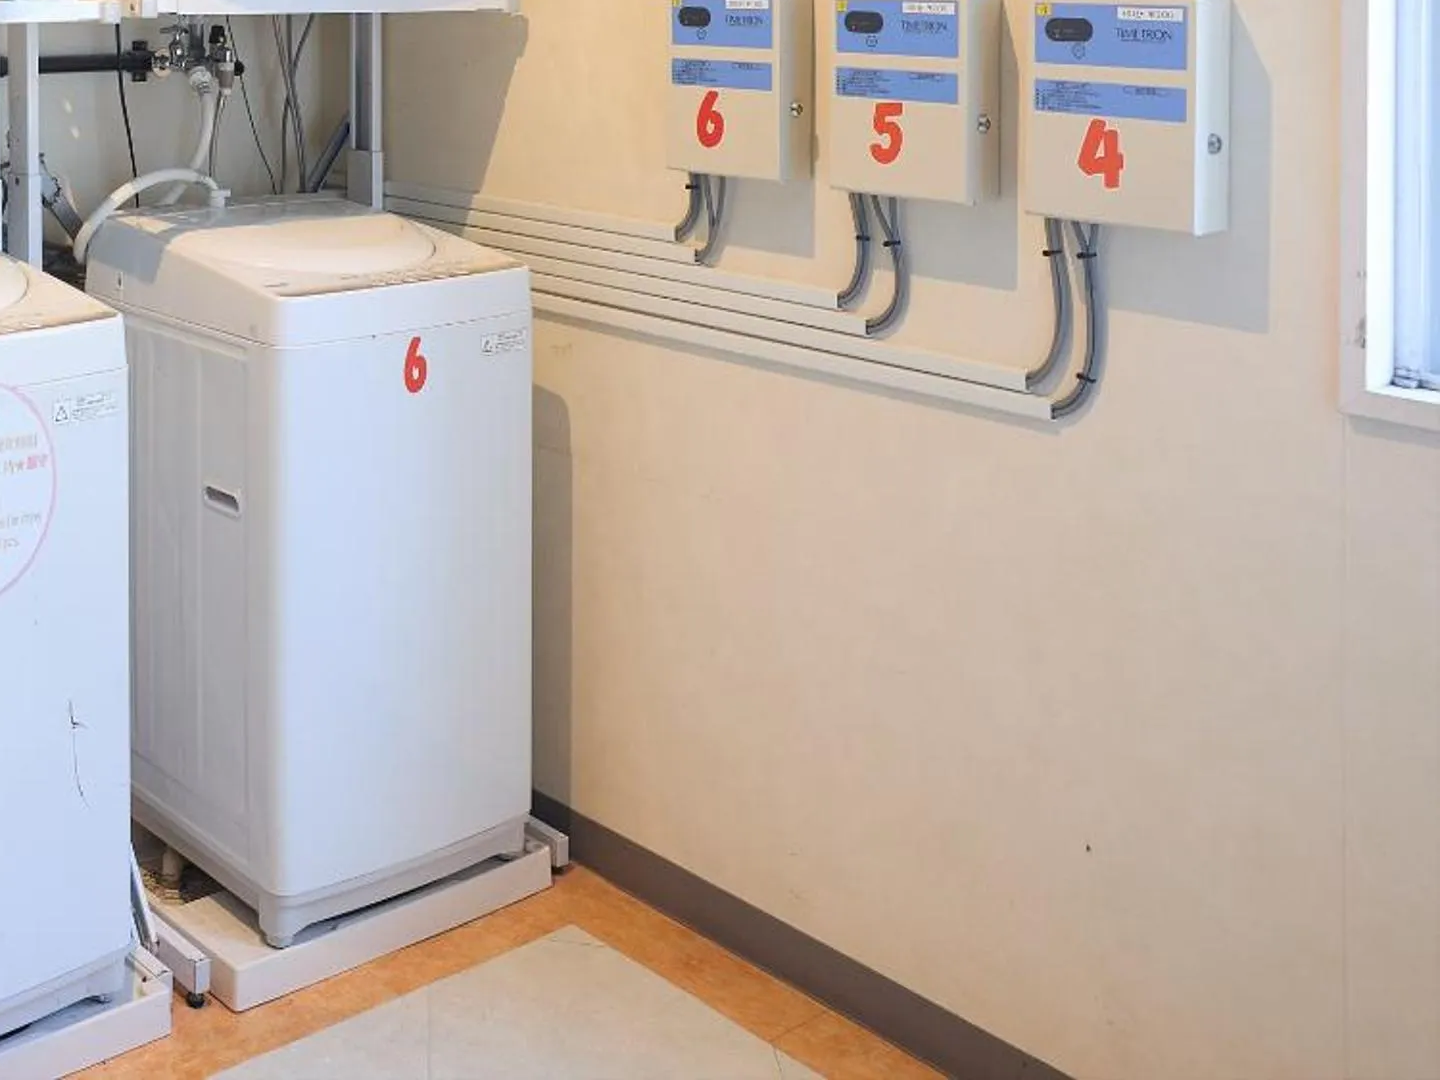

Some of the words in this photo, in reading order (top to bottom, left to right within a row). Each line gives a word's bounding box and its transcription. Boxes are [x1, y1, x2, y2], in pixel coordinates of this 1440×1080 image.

[696, 89, 725, 149] 6
[870, 102, 904, 166] 5
[1078, 119, 1124, 189] 4
[404, 336, 427, 393] 6
